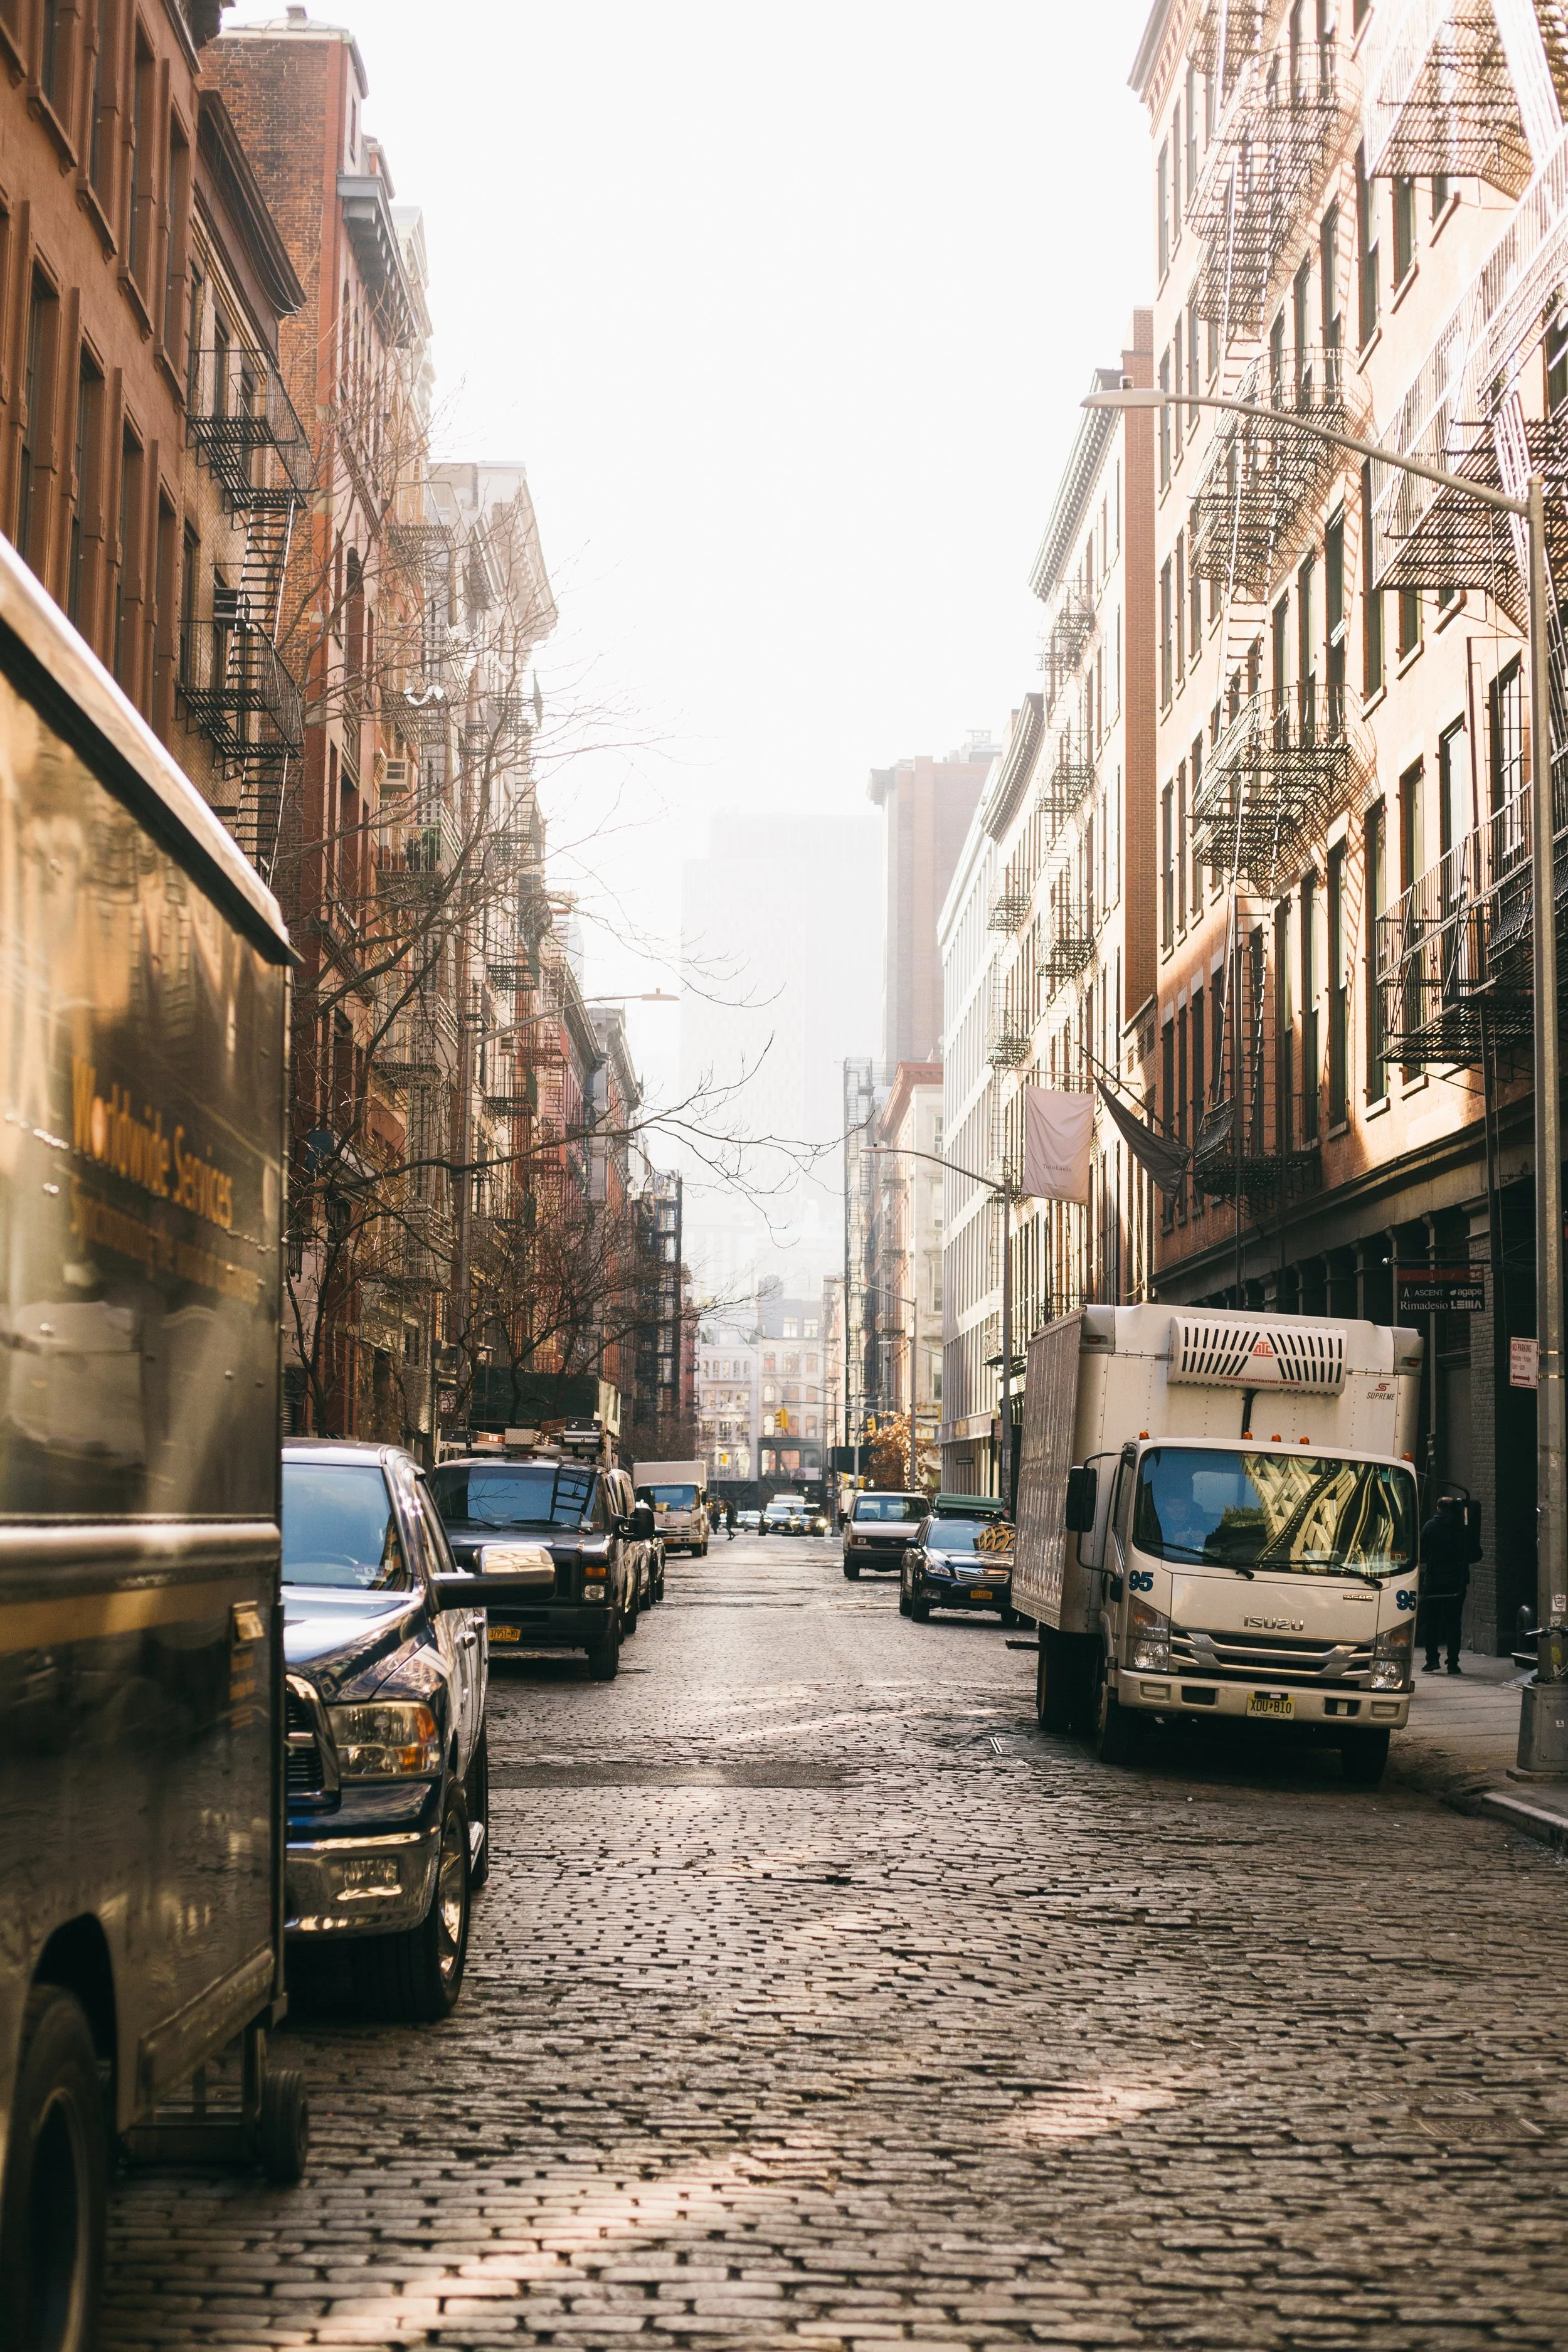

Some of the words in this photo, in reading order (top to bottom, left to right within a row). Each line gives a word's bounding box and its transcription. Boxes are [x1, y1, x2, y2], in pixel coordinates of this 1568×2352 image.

[1458, 1288, 1482, 1297] agape
[1400, 1300, 1448, 1310] Rimadesio
[1253, 1341, 1273, 1354] ATC
[1517, 1343, 1532, 1353] PARKING
[1366, 1392, 1396, 1401] SUPREME
[1128, 1570, 1154, 1592] 95
[1396, 1589, 1417, 1611] 95
[1244, 1615, 1305, 1631] ISUZU
